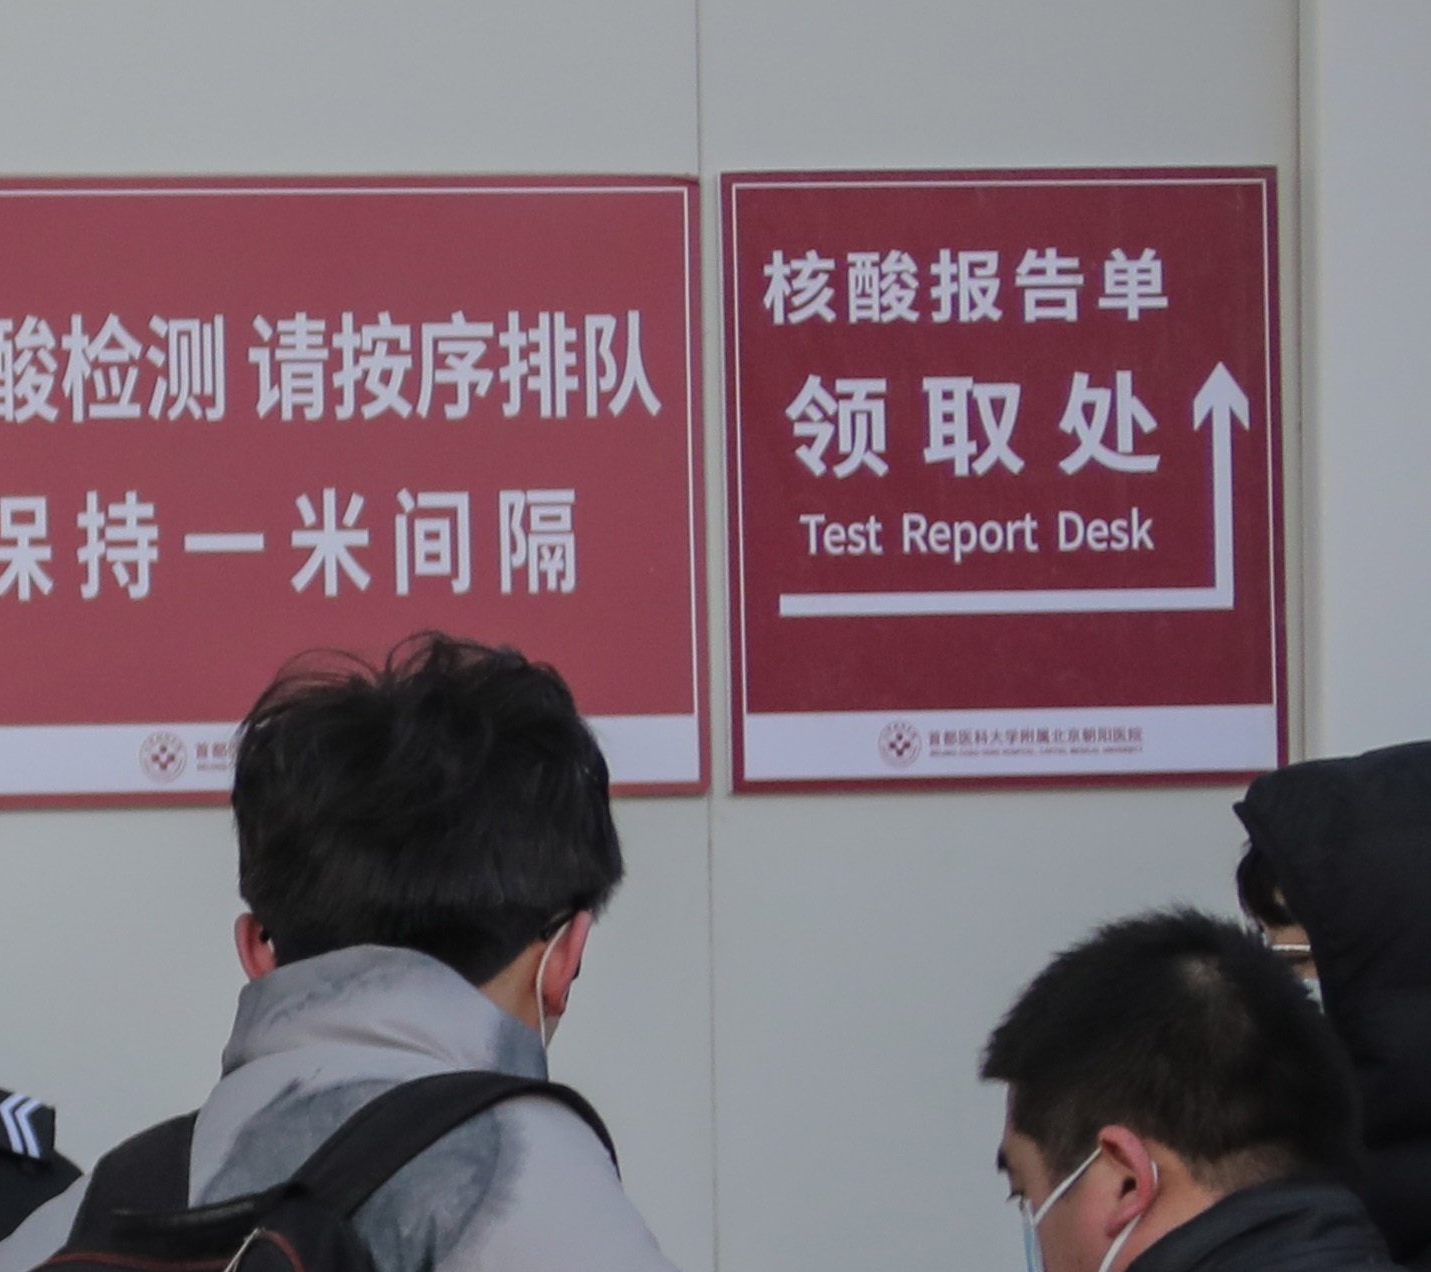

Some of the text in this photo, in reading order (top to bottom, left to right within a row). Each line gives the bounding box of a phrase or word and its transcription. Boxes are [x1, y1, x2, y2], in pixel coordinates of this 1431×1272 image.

[763, 247, 1169, 325] 核酸报告单
[248, 310, 662, 421] 请按序排队
[785, 370, 1161, 479] 领取处
[799, 507, 1154, 563] Test Report Desk
